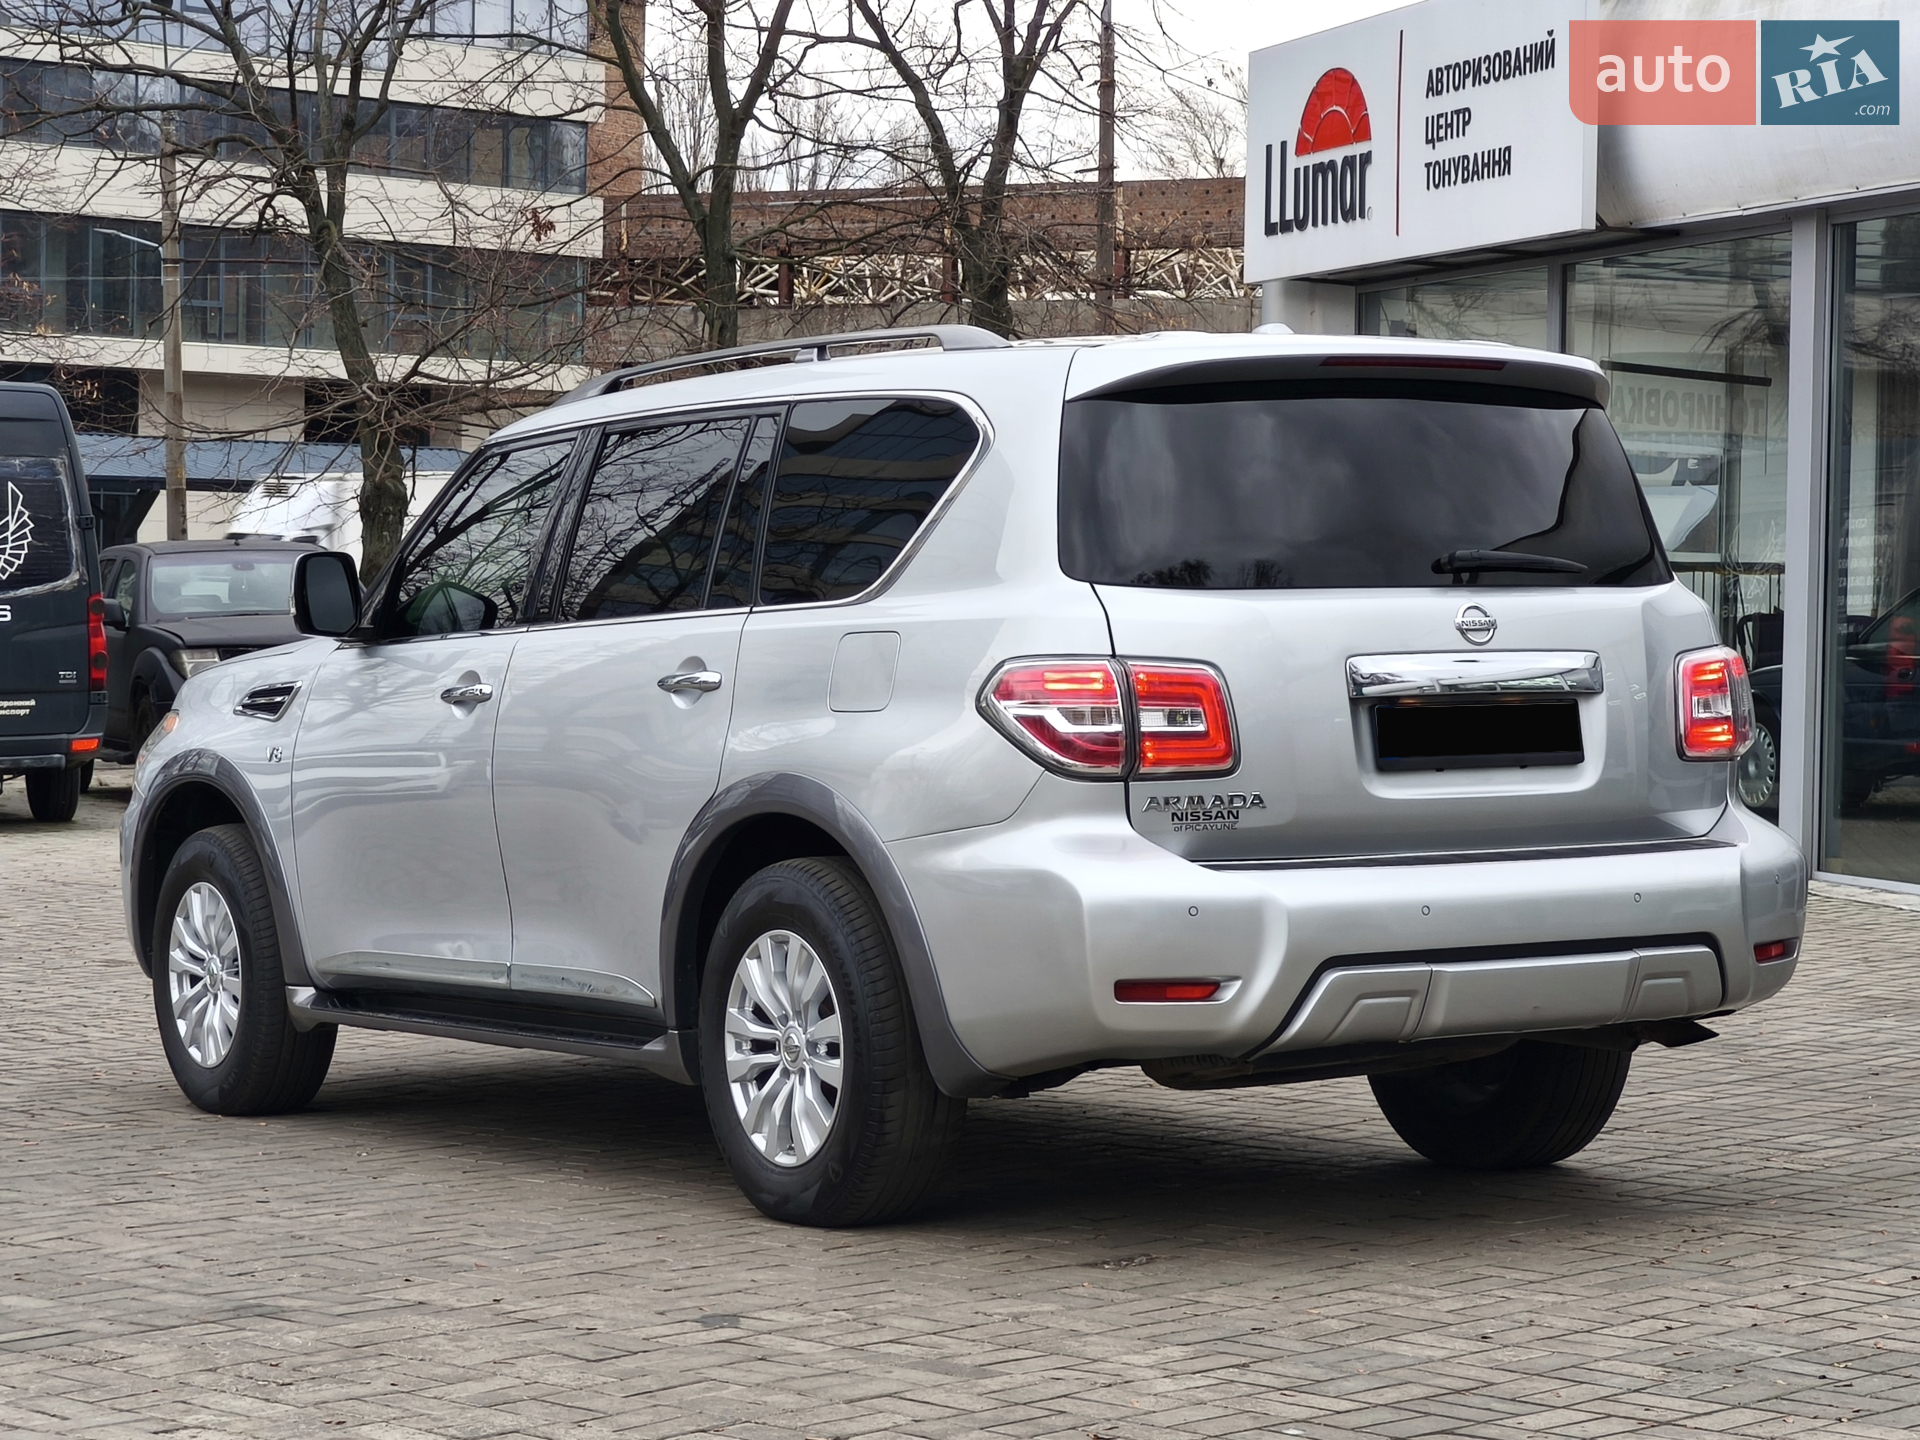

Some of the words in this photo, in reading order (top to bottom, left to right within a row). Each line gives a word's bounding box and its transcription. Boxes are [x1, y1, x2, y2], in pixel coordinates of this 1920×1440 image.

[1425, 30, 1556, 100] АВТОРИЗОВАНИЙ
[1424, 107, 1472, 151] ЦЕНТР
[1424, 145, 1512, 191] ТОНУВАННЯ
[1264, 140, 1372, 238] LLumar
[1461, 618, 1497, 628] NISSAN
[1142, 791, 1267, 812] ARMADA
[1171, 809, 1240, 822] NISSAN
[1173, 824, 1183, 832] of
[1184, 822, 1238, 832] PICAYUNE
